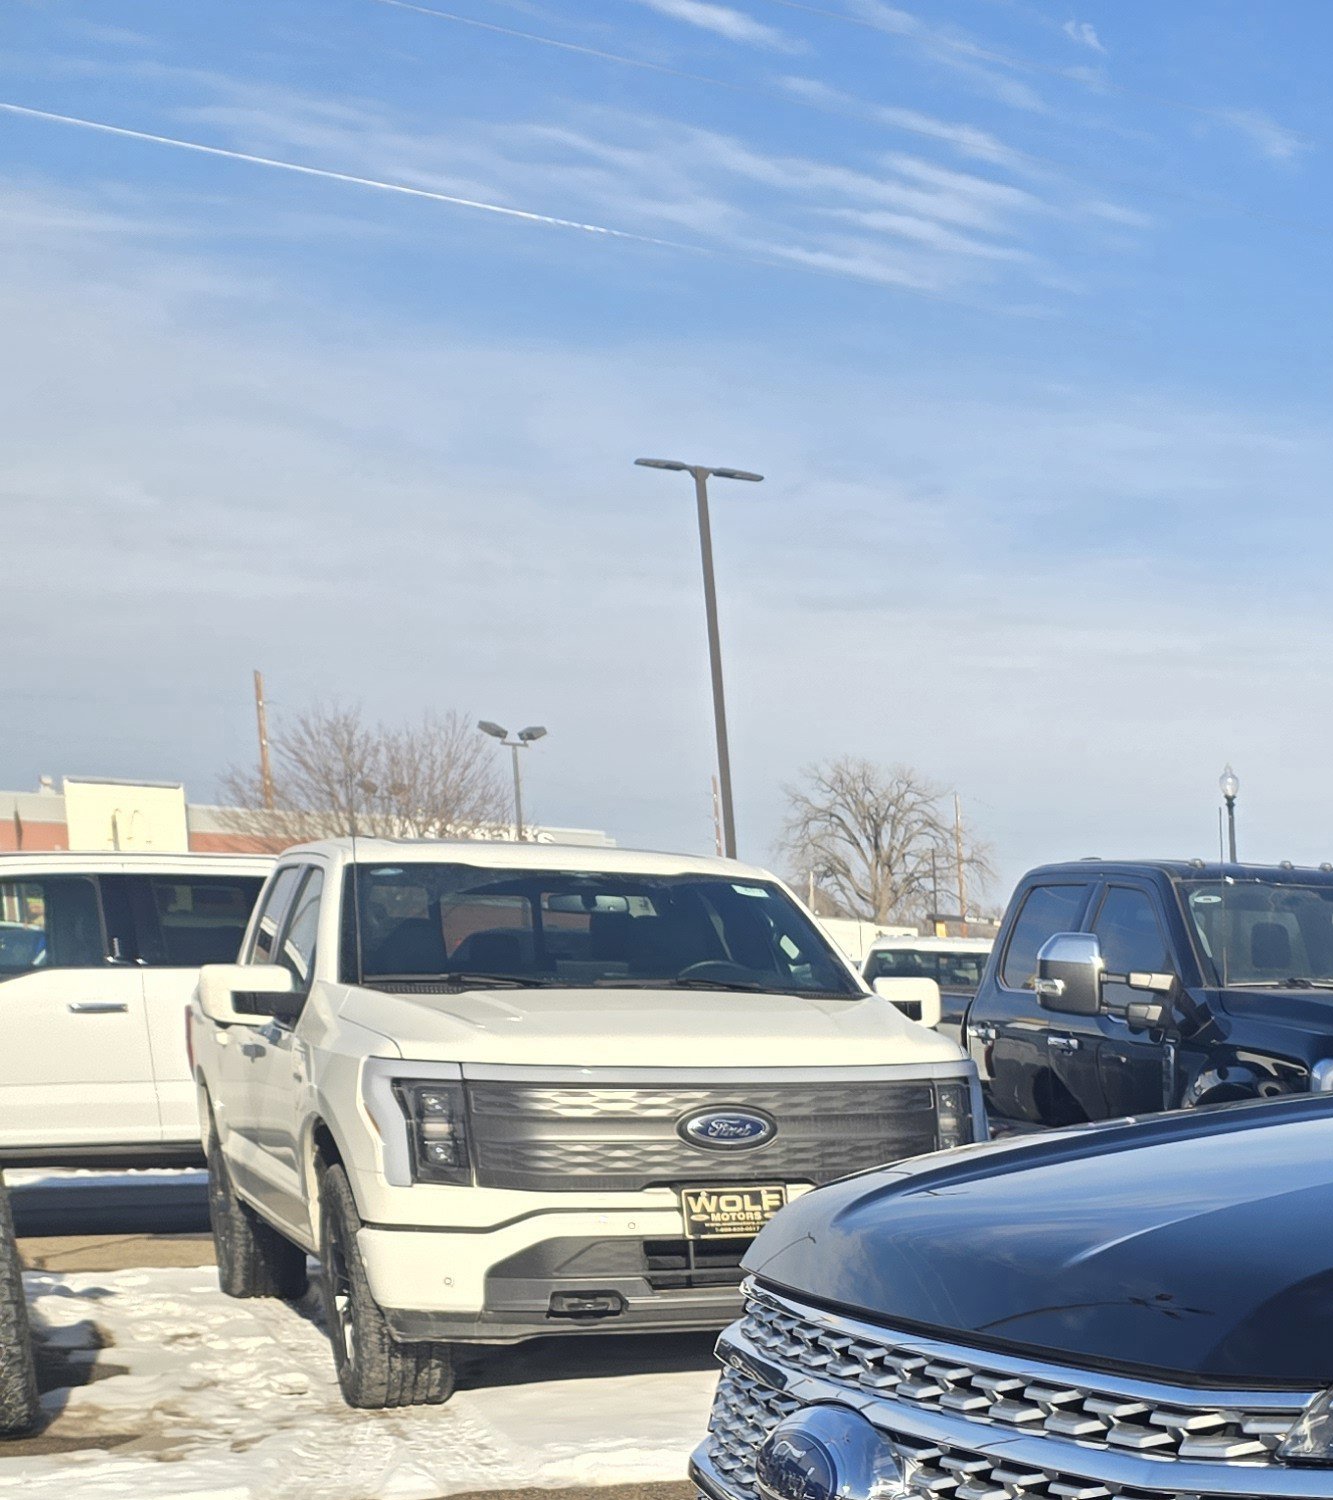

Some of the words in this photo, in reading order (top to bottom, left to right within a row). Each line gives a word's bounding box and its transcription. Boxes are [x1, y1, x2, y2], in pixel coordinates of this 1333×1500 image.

[708, 1119, 752, 1137] Ford
[687, 1193, 782, 1213] WOLF
[711, 1211, 762, 1222] MOTORS
